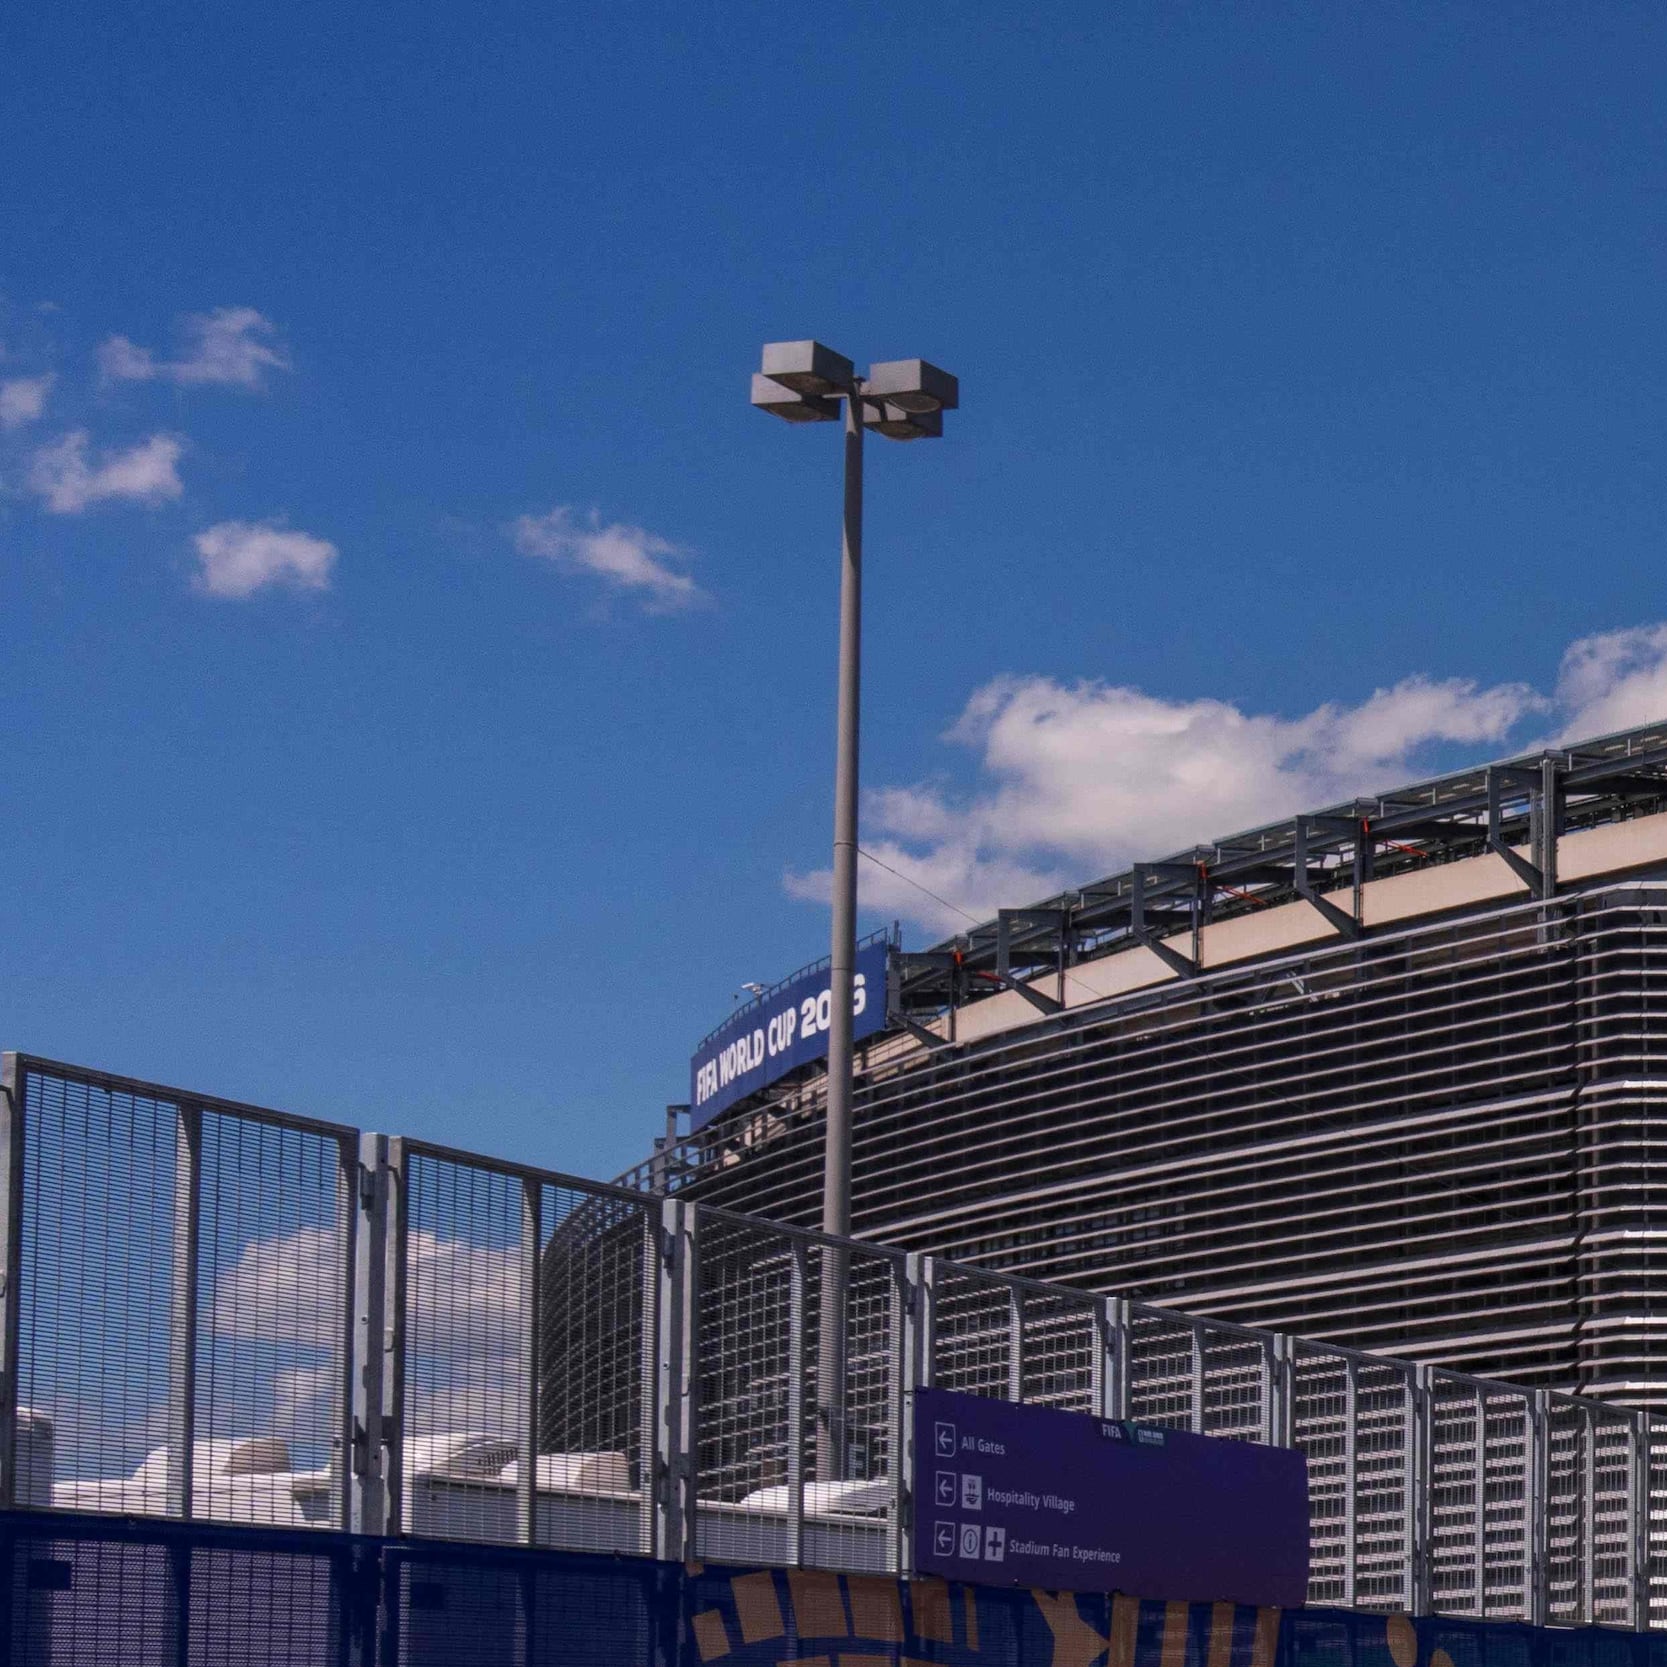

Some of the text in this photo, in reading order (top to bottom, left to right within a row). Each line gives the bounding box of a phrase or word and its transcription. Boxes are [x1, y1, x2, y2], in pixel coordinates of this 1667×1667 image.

[697, 973, 866, 1106] FIFA WORLD CUP 206
[1102, 1423, 1121, 1439] FIFA
[962, 1436, 1006, 1455] All Gates
[987, 1487, 1076, 1514] Hospitality Village
[1010, 1539, 1121, 1564] Stadium Fan Experience
